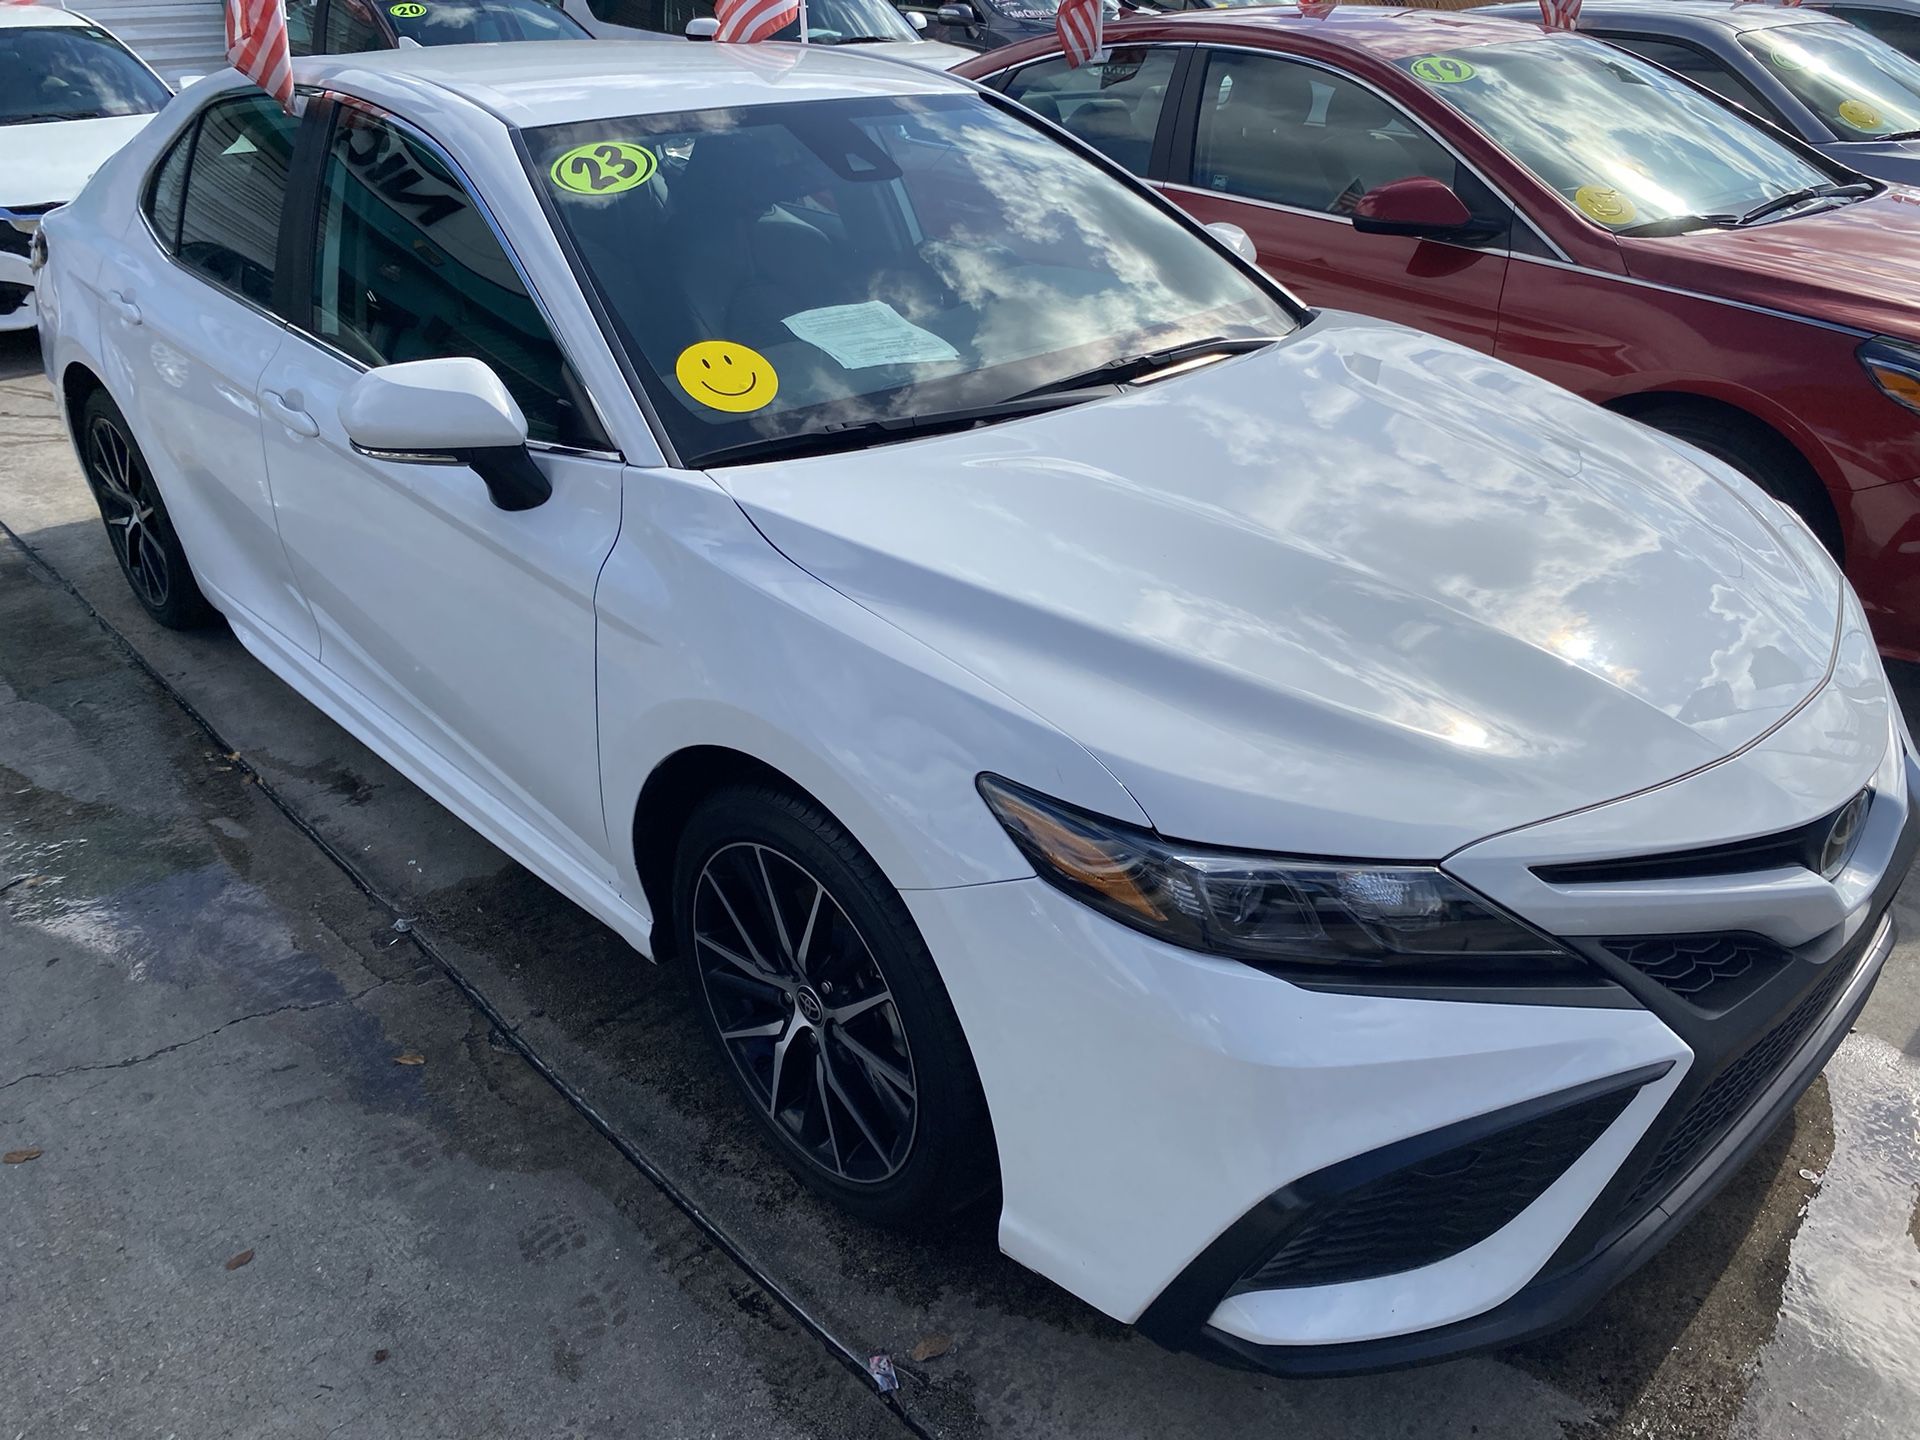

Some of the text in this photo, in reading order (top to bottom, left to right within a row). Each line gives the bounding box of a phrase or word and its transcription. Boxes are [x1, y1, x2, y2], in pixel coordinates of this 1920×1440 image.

[397, 5, 420, 16] 20
[1422, 60, 1462, 81] 19
[571, 145, 638, 191] 23
